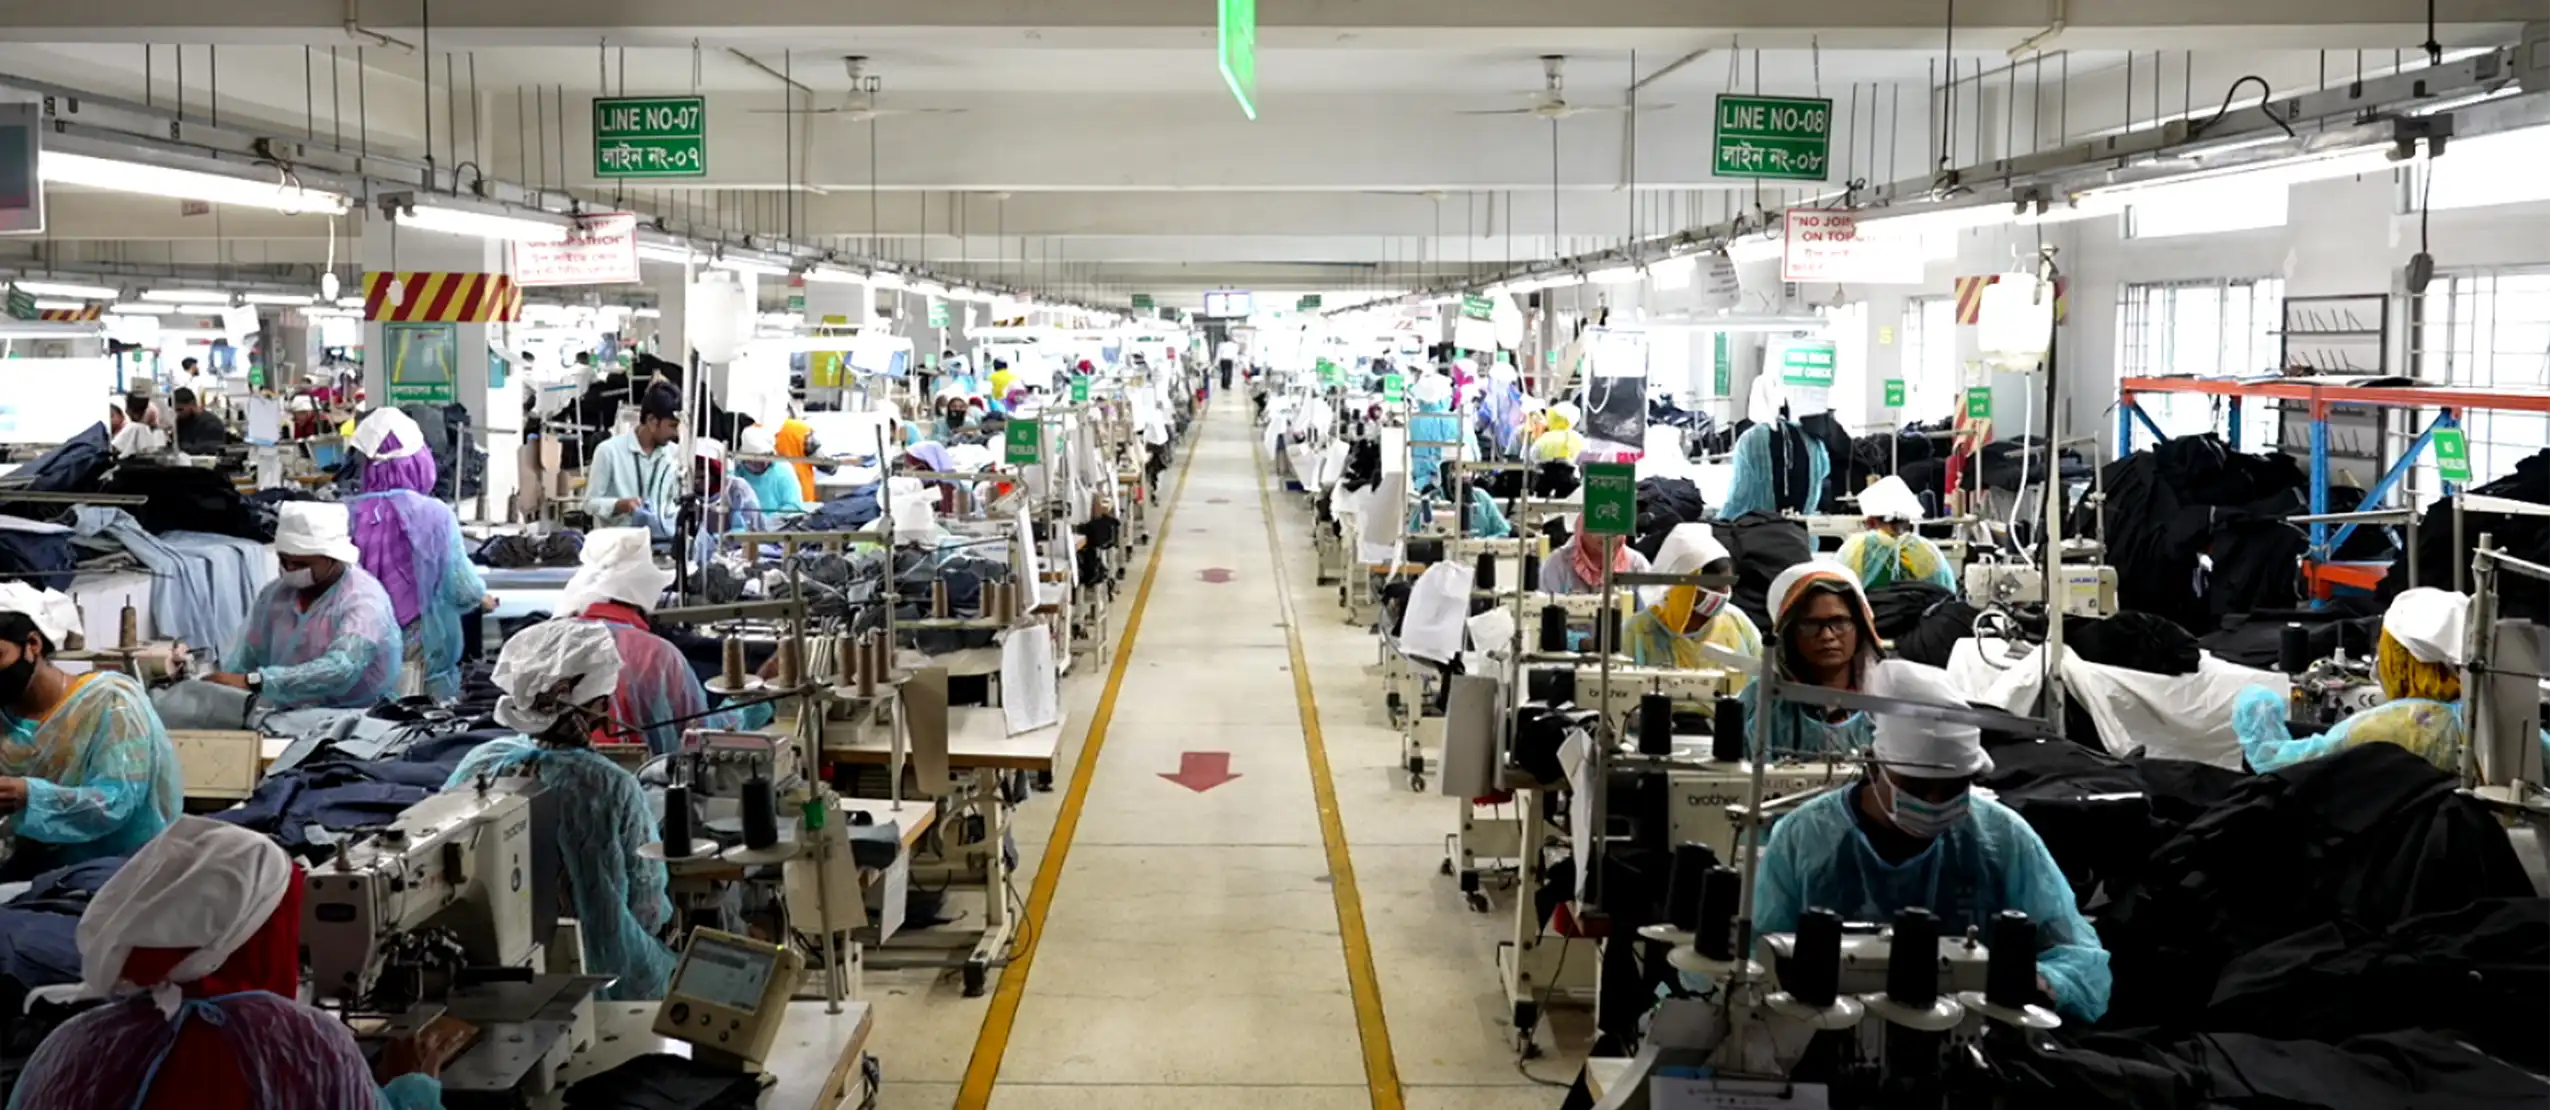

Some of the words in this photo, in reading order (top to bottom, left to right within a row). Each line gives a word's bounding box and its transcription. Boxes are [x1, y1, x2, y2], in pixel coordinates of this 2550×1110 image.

[600, 107, 641, 131] LINE
[645, 106, 699, 131] NO-07
[1723, 105, 1765, 130] LINE
[1770, 107, 1825, 133] NO-08
[601, 140, 643, 171] লাইন
[645, 146, 700, 169] নং-০৭
[1721, 140, 1765, 172] লাইন
[1768, 147, 1823, 172] নং-০৮
[1802, 231, 1823, 242] ON
[1828, 231, 1855, 242] TOP
[1595, 500, 1622, 521] নেই
